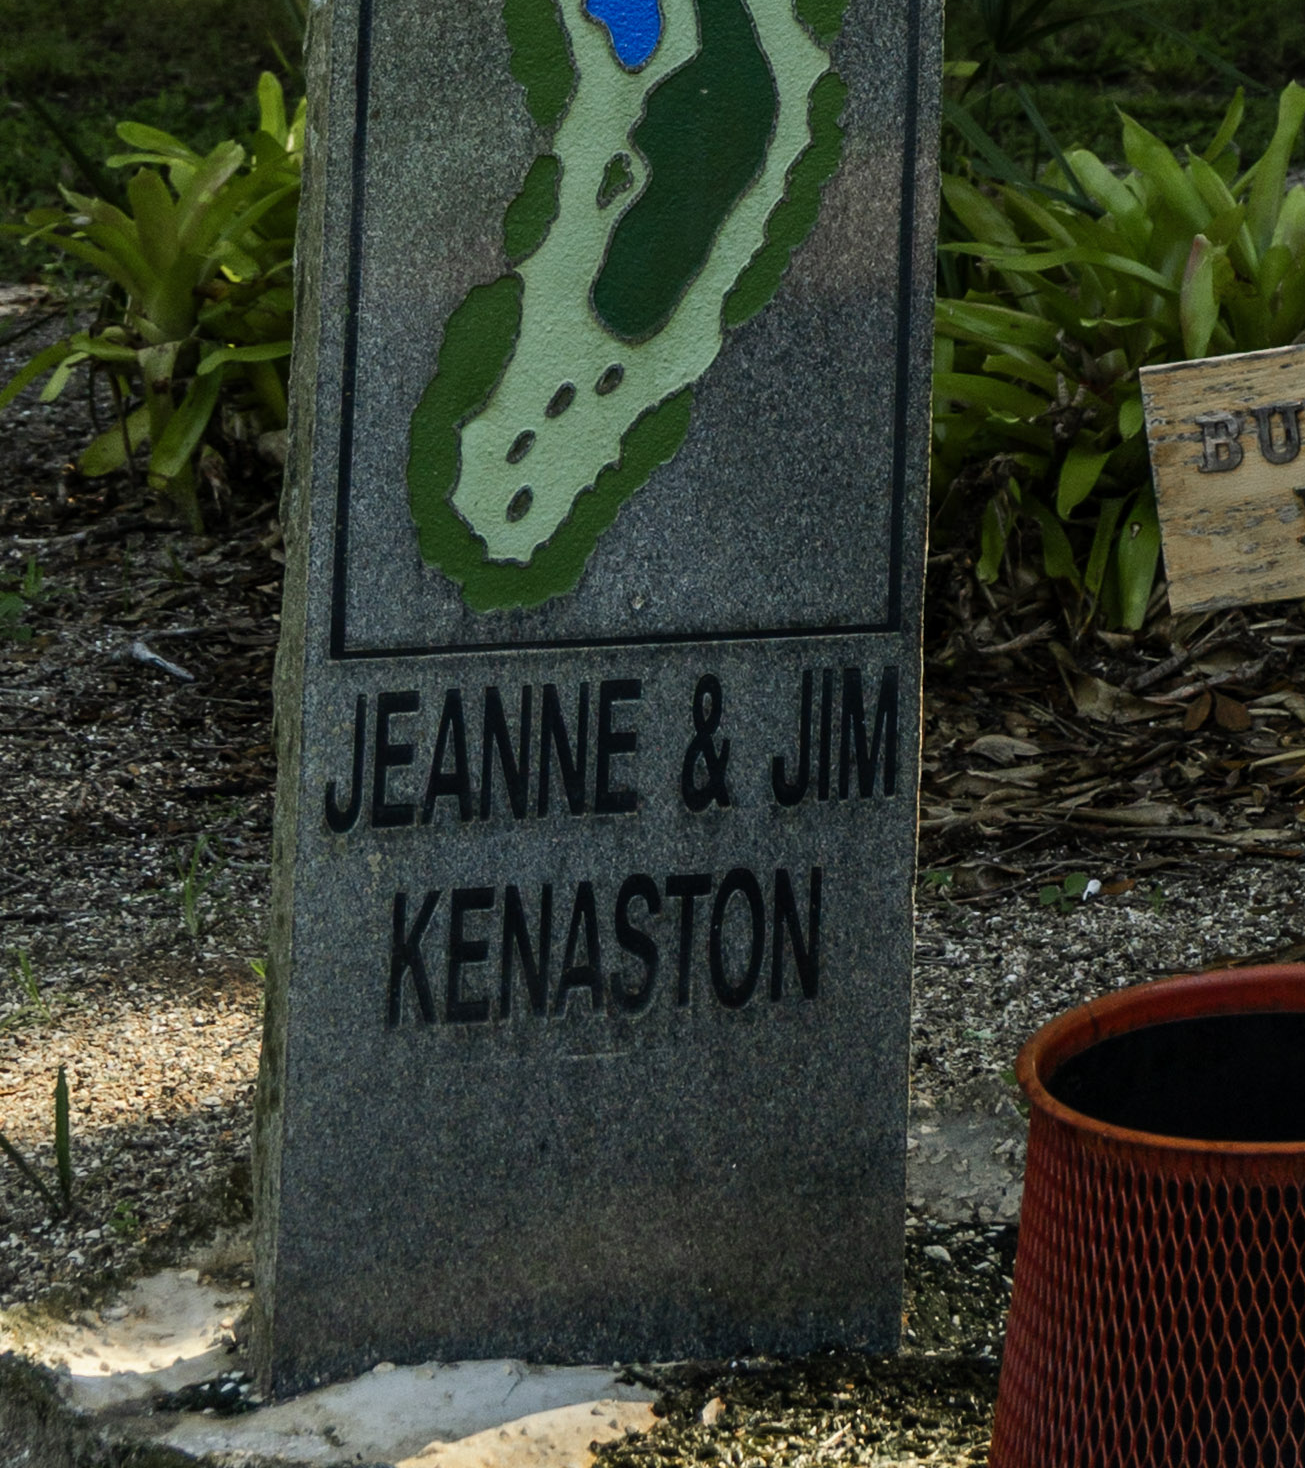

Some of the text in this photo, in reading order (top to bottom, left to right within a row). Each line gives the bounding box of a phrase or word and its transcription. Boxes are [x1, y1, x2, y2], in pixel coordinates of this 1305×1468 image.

[325, 665, 900, 834] JEANNE & JIM
[388, 868, 823, 1027] KENASTON
